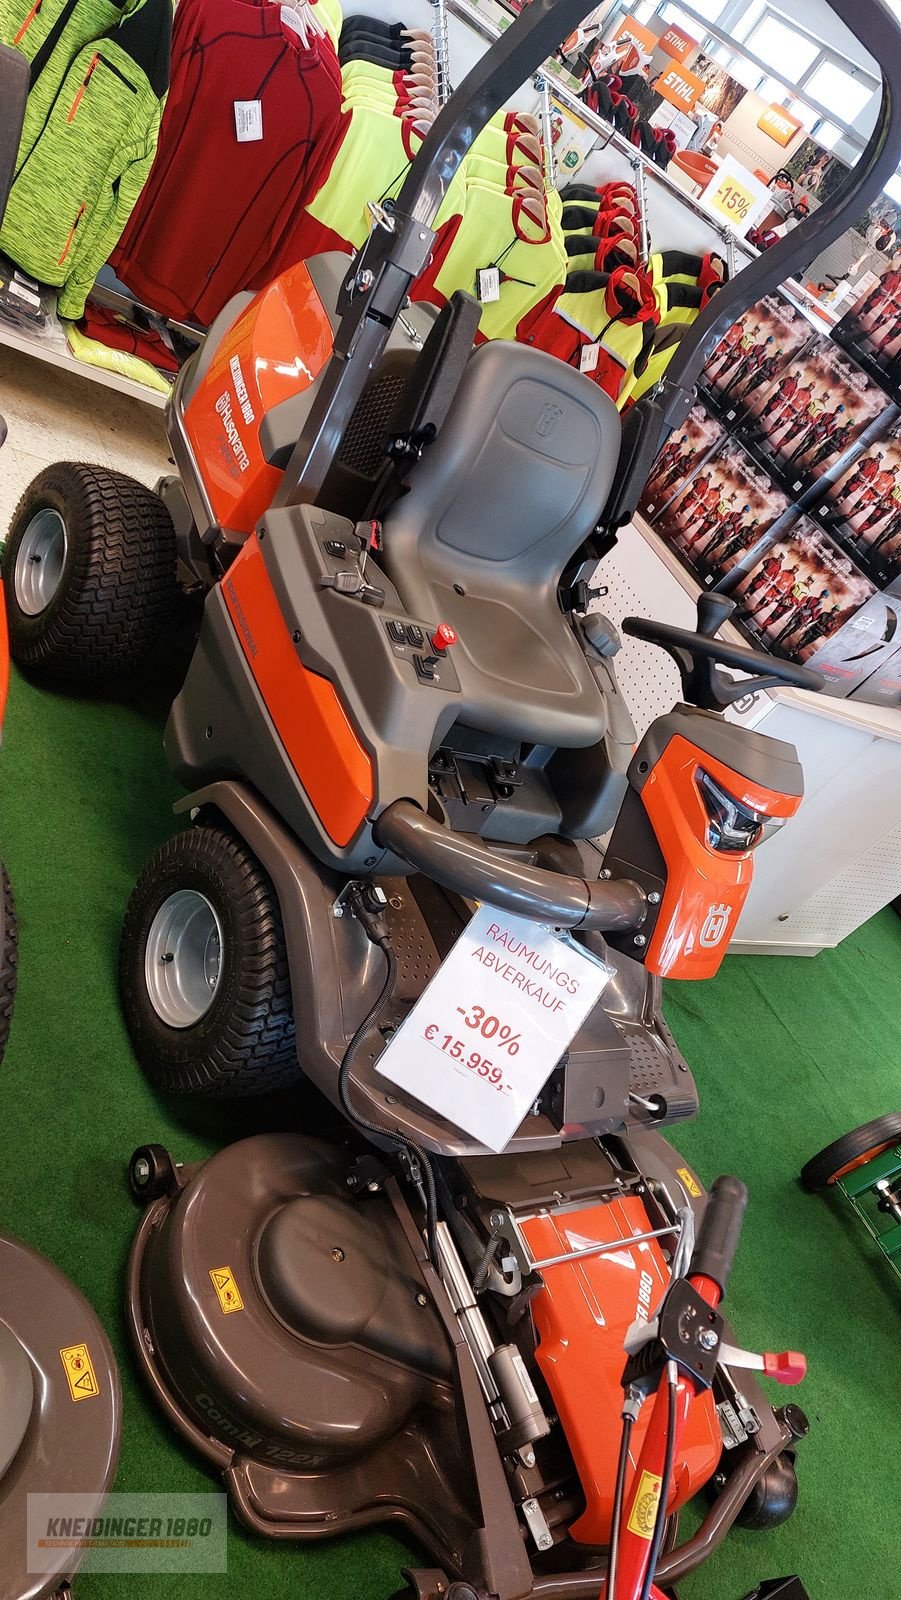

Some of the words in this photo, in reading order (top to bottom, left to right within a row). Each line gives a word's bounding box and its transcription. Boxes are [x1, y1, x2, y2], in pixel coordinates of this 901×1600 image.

[663, 31, 688, 53] STIHL
[663, 71, 695, 103] STIHL
[763, 110, 792, 135] STIHL
[717, 187, 750, 219] -15%
[240, 399, 255, 425] 1880
[219, 404, 250, 472] Husqvarna
[471, 946, 567, 1012] ABVERKAUF
[486, 923, 580, 994] RÄUMUNGS
[456, 1005, 521, 1056] -30%
[424, 1024, 439, 1040] €
[441, 1035, 513, 1091] 15.959,-
[638, 1270, 653, 1309] 1880
[194, 1393, 263, 1448] Combi
[265, 1446, 328, 1465] 122X
